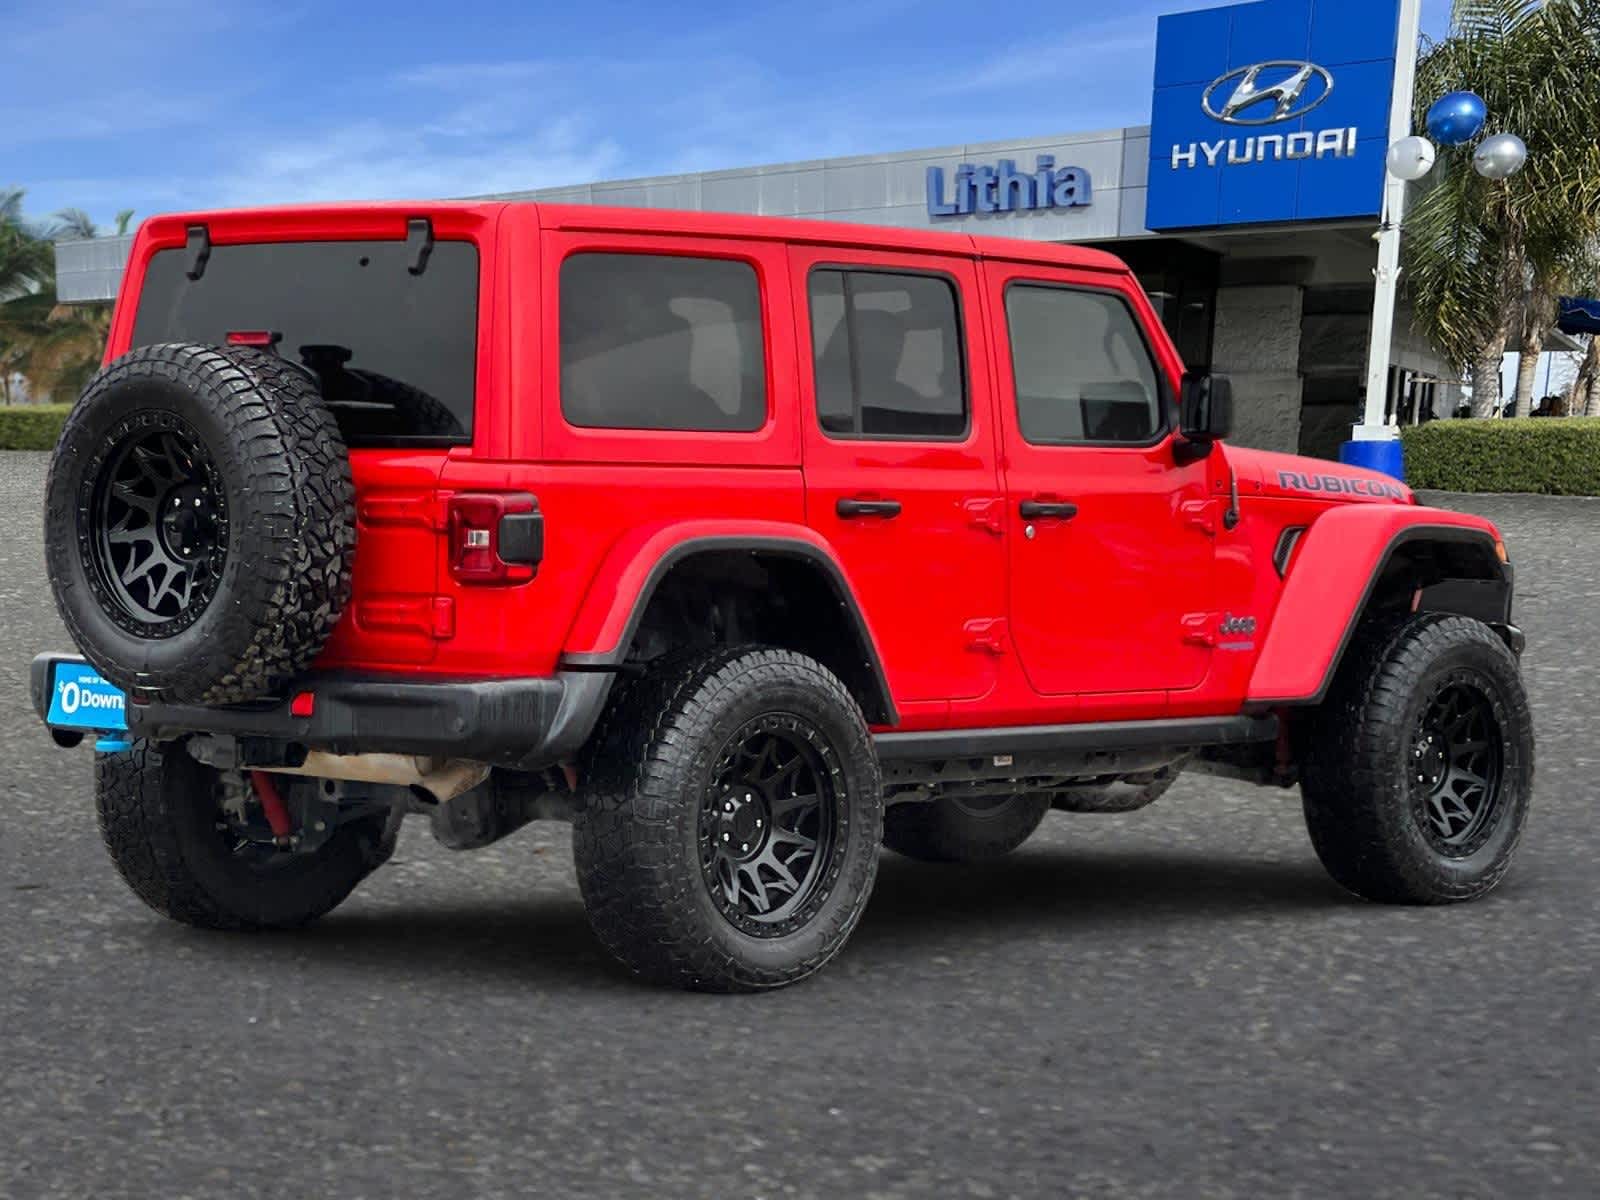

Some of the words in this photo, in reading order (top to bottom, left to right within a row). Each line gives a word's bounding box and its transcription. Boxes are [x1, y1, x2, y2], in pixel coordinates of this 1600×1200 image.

[1171, 127, 1358, 169] HYUNDAI
[926, 155, 1093, 216] Lithia
[1277, 470, 1403, 499] RUBICON
[1219, 611, 1257, 636] Jeep
